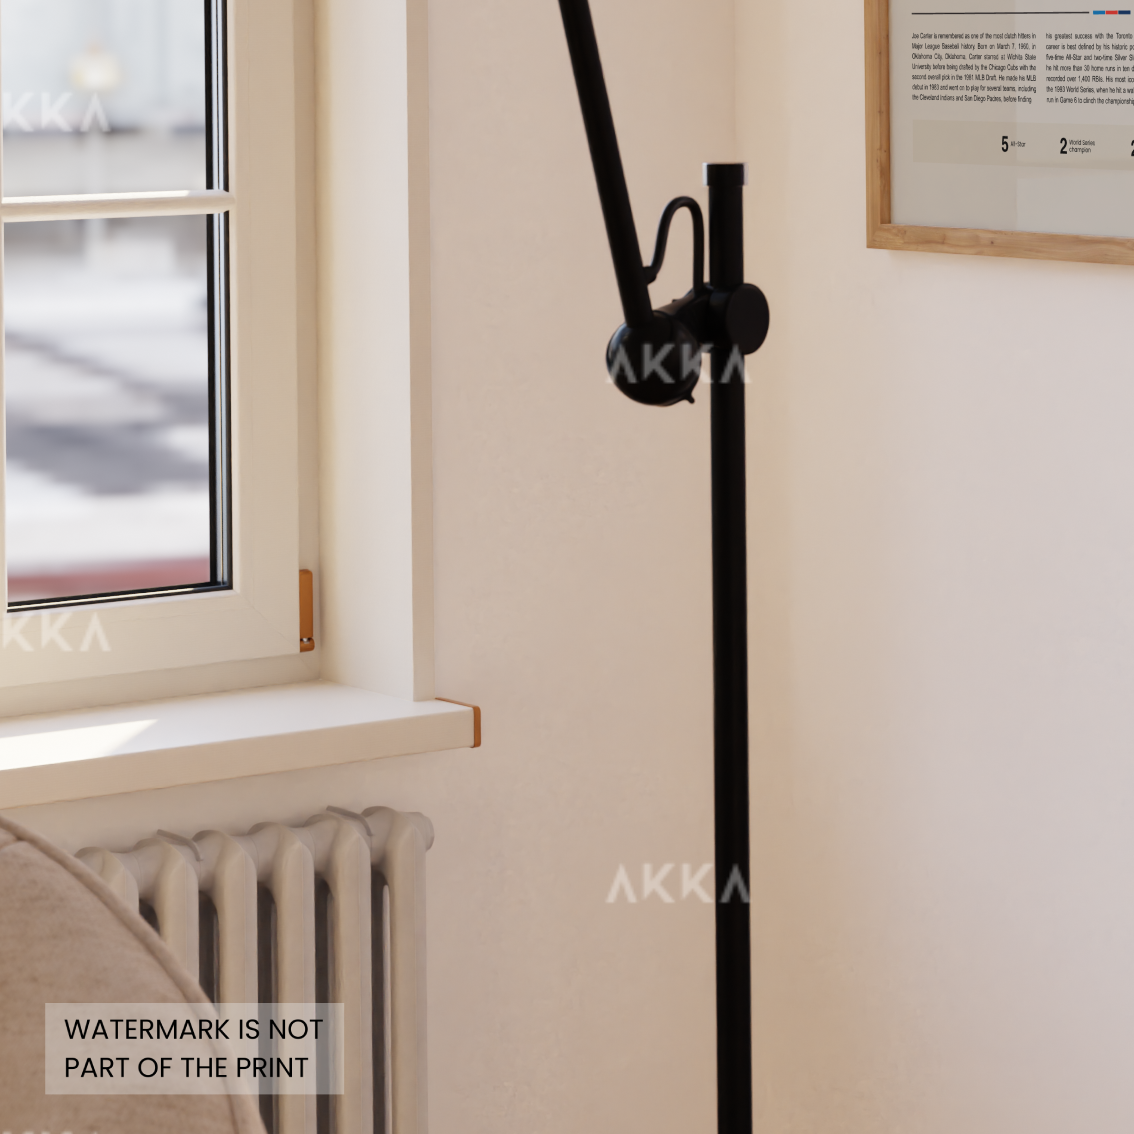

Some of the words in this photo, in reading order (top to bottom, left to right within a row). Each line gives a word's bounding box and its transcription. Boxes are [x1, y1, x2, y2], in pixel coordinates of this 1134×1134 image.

[1054, 33, 1072, 41] greatest
[1096, 43, 1102, 51] by
[1002, 136, 1008, 152] 5
[1060, 137, 1067, 154] 2
